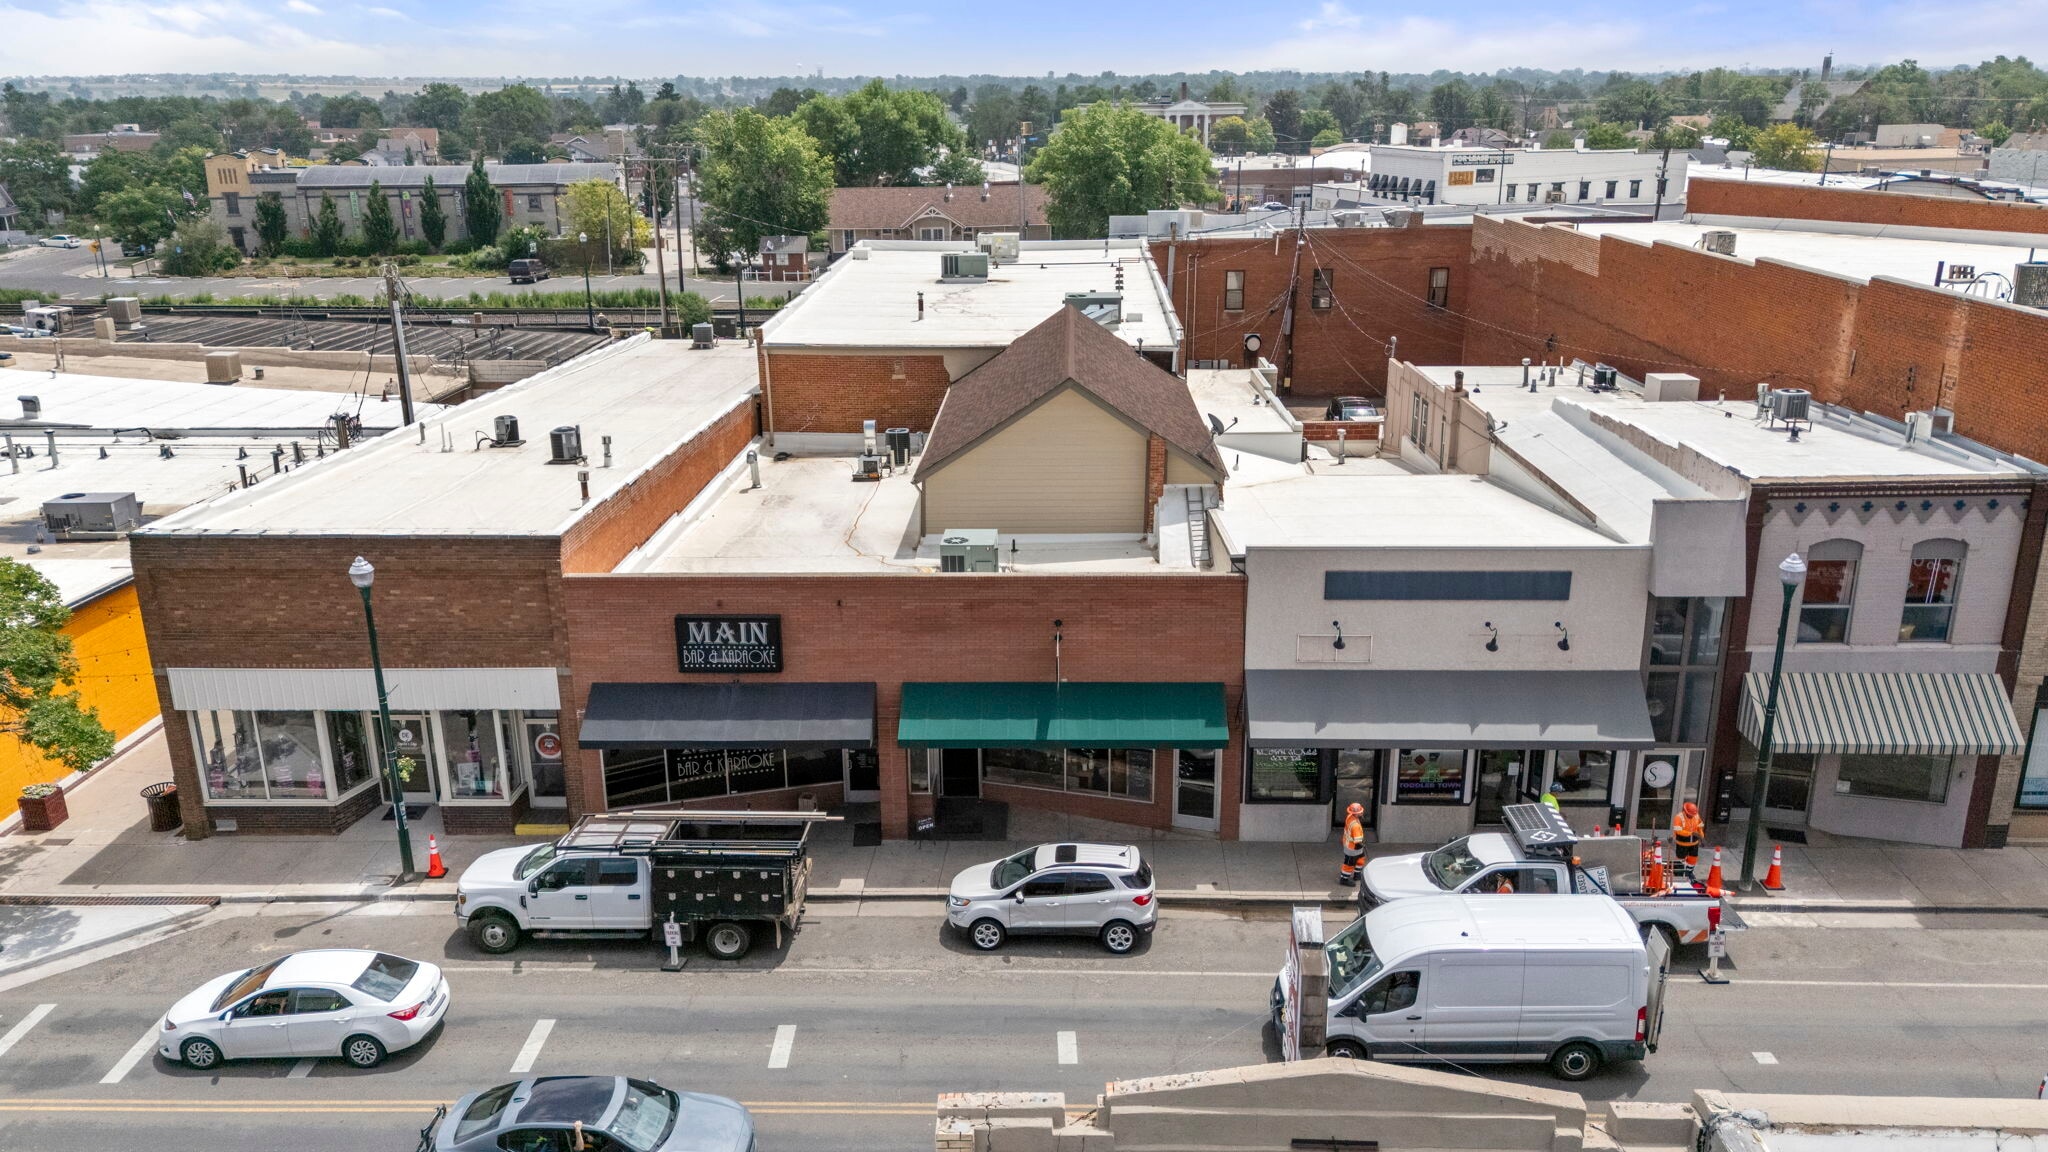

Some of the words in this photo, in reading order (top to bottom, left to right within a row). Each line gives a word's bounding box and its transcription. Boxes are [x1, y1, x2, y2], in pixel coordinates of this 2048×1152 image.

[687, 621, 768, 645] MAIN
[683, 649, 705, 664] BAR
[708, 649, 717, 664] &
[722, 649, 775, 664] KARAOKE
[677, 760, 700, 777] BAR
[703, 759, 713, 773] &
[717, 752, 775, 772] KARAOKE
[918, 822, 934, 831] OPEN
[1577, 874, 1588, 894] LOSED
